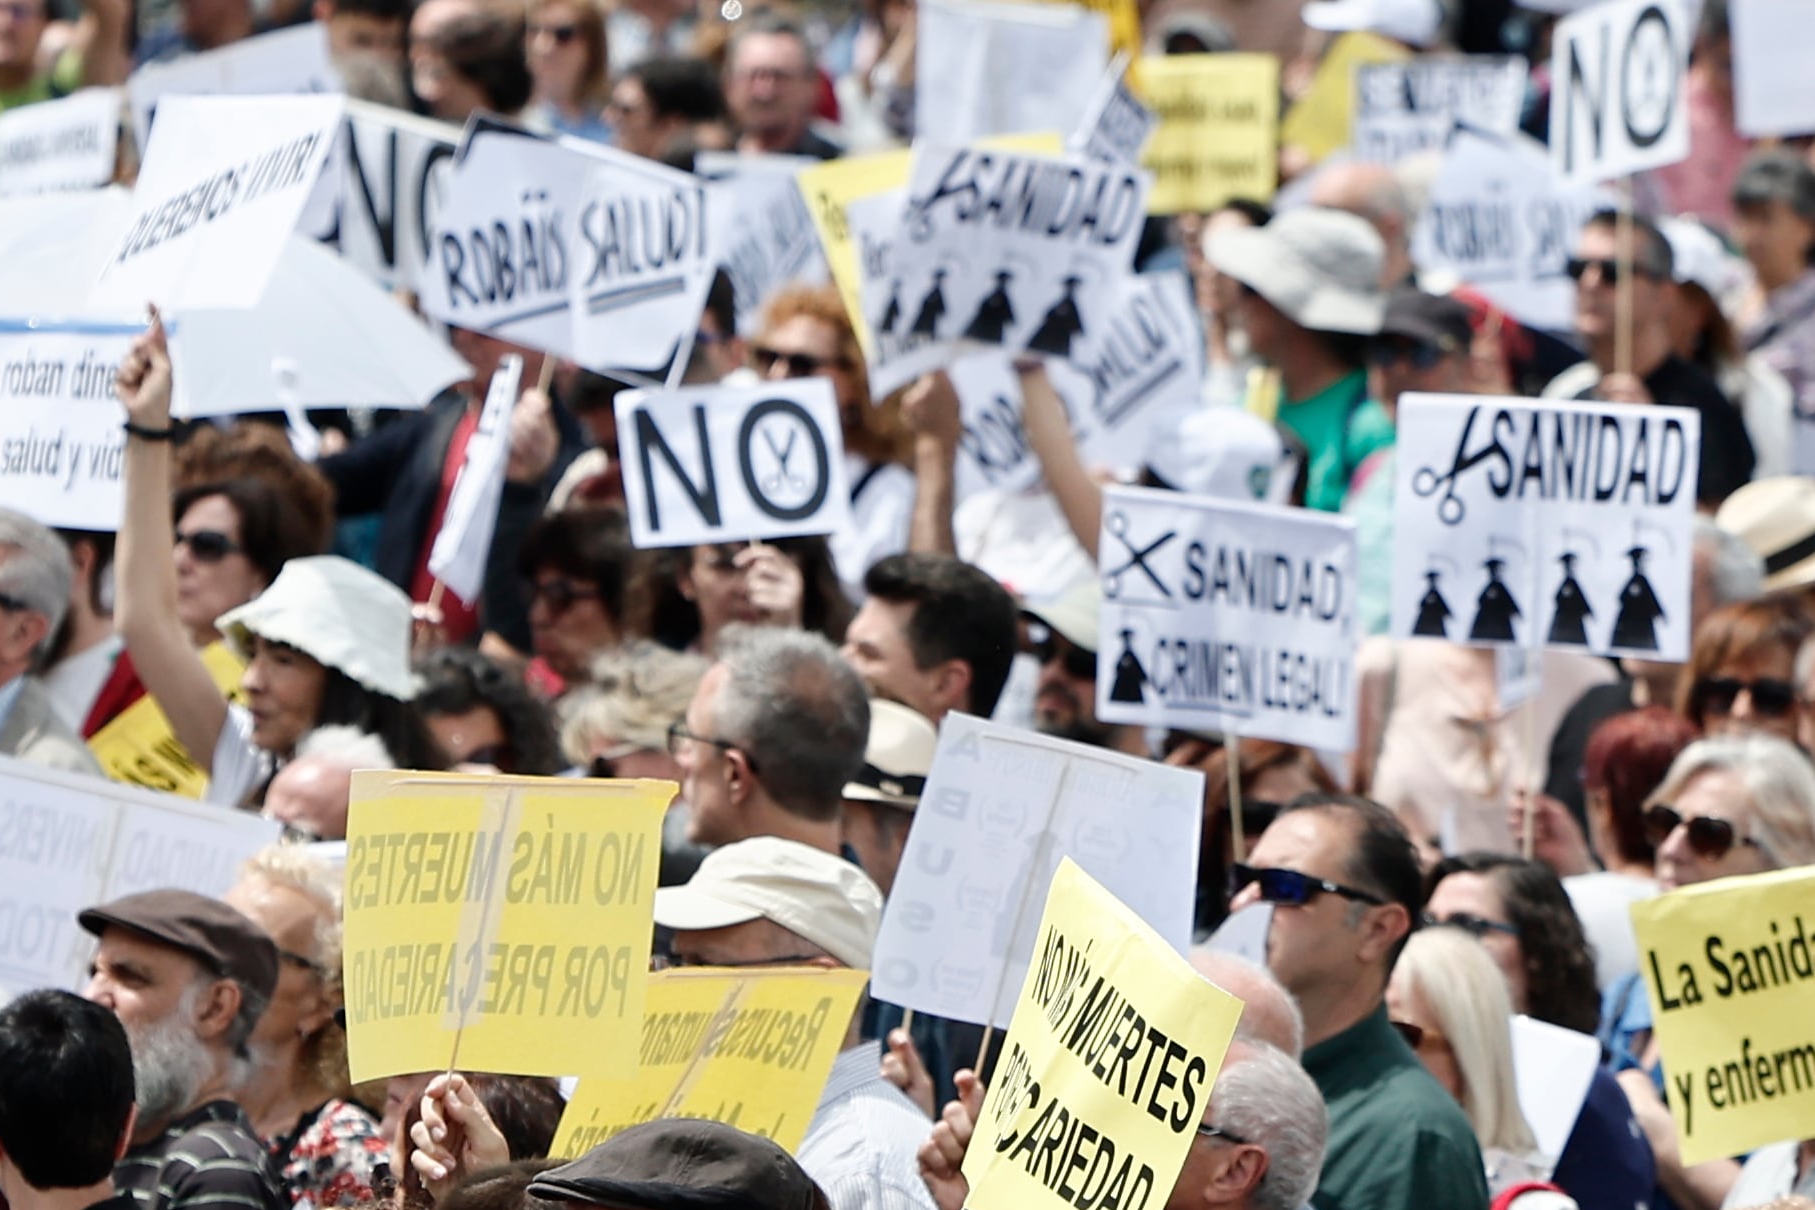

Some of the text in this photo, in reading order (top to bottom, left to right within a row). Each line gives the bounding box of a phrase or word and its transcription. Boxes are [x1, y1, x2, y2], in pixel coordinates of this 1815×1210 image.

[1564, 5, 1676, 173] NO
[956, 156, 1137, 246] SANIDAD
[3, 349, 63, 397] roban
[70, 349, 120, 399] dine
[1, 426, 64, 477] salud
[64, 443, 82, 491] y
[89, 431, 123, 480] vid
[634, 397, 829, 533] NO
[1487, 408, 1684, 505] SANIDAD
[1151, 636, 1252, 704] CRIMEN
[1649, 916, 1815, 1012] La Sanid
[1060, 976, 1206, 1134] MUERTES
[1676, 1071, 1693, 1137] y
